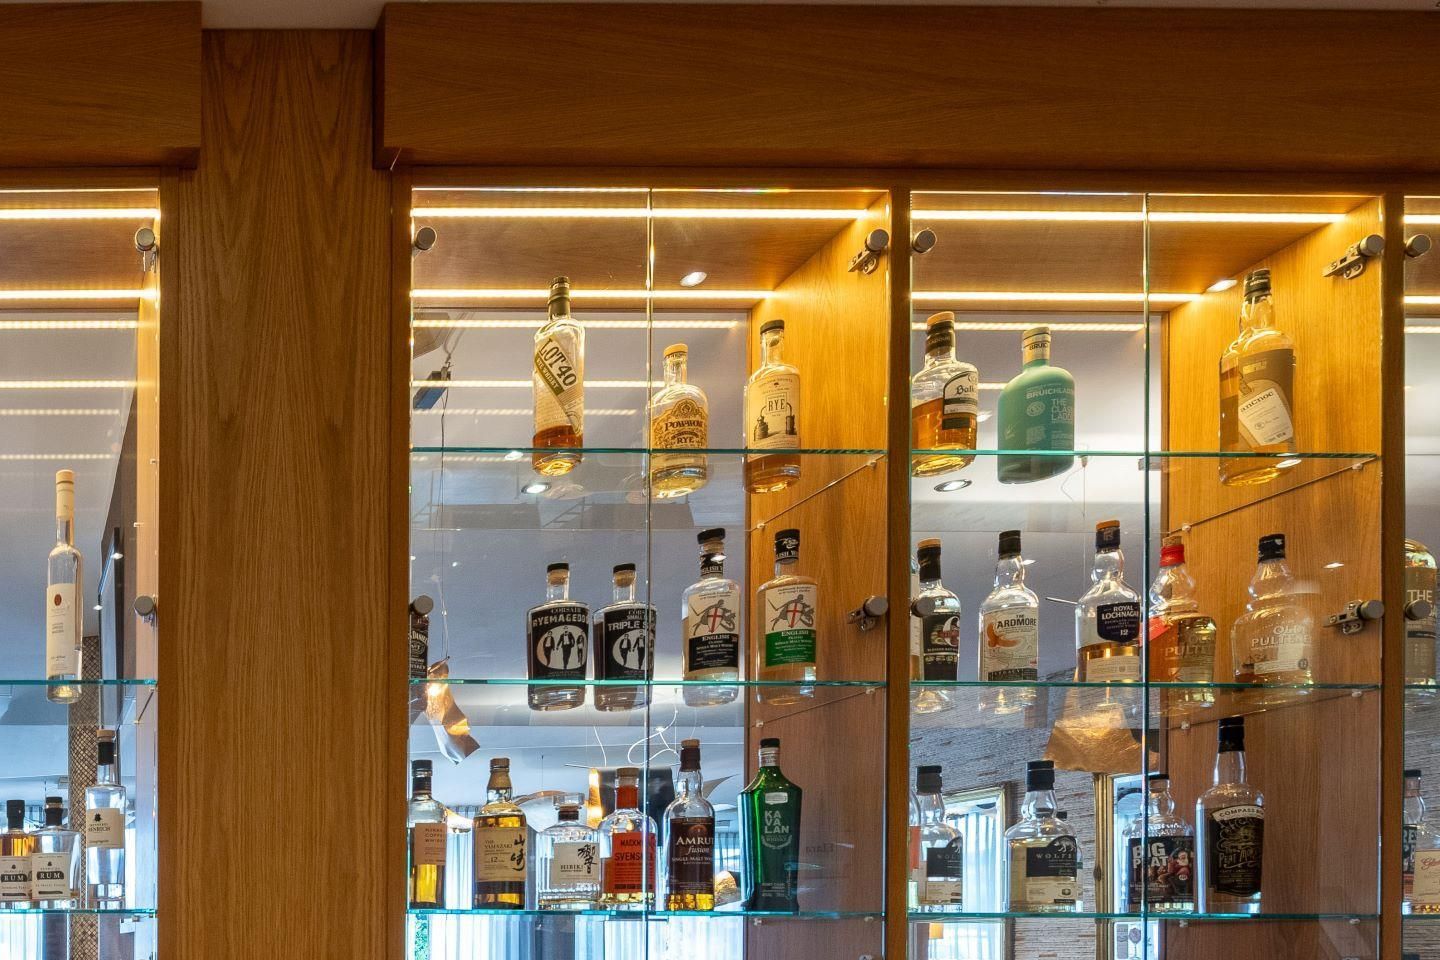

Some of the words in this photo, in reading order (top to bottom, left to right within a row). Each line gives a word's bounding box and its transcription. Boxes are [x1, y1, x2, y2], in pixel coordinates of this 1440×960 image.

[539, 339, 567, 368] LOT
[557, 365, 577, 387] 40
[768, 399, 785, 412] RYE
[1407, 590, 1433, 603] THE
[608, 620, 640, 631] TRIPLE
[997, 618, 1037, 629] ARDMORE
[781, 629, 809, 637] ENGLISH
[765, 810, 781, 819] KA
[765, 826, 789, 834] LAN
[676, 836, 713, 845] AMRUT
[687, 845, 710, 855] fusion
[1133, 856, 1168, 869] PAT
